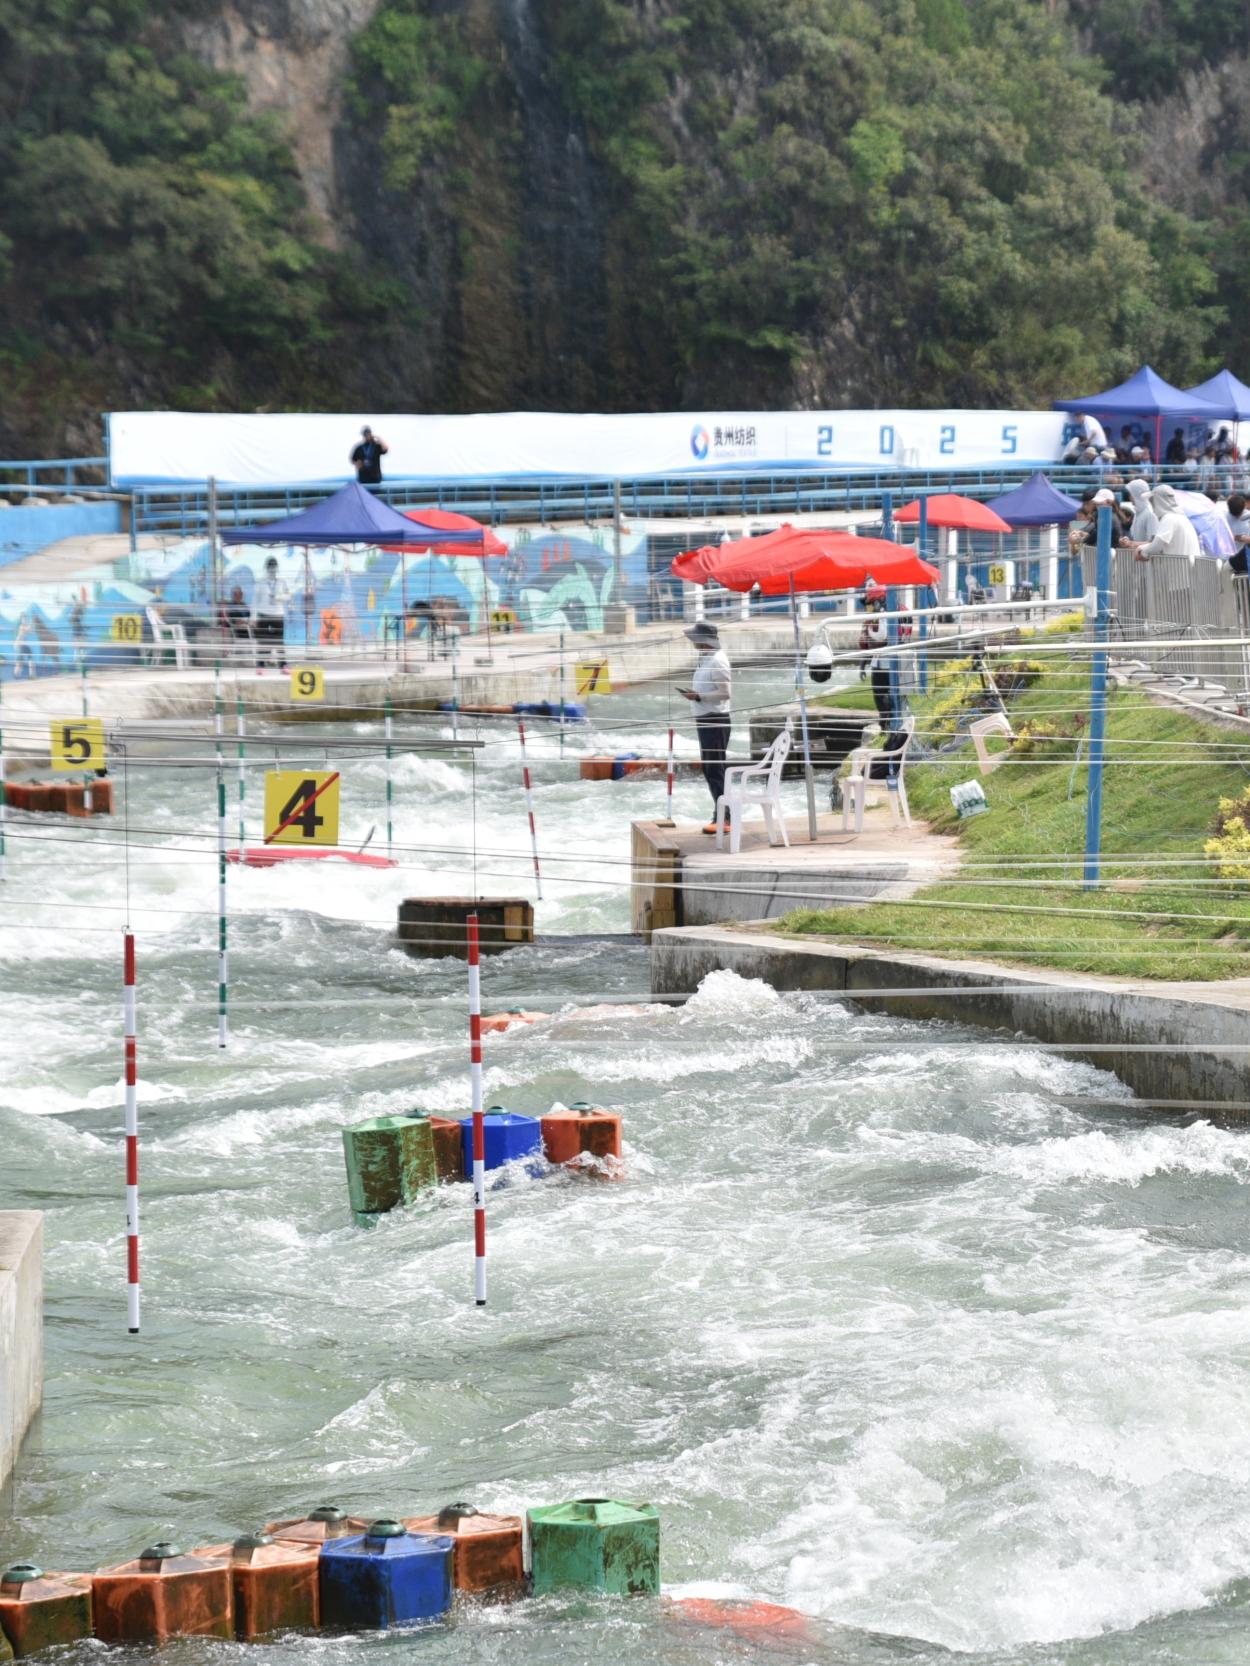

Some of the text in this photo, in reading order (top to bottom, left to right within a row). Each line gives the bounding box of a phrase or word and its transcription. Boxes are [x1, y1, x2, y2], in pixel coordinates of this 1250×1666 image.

[713, 426, 756, 446] 贵州纺织
[990, 567, 1005, 583] 13
[116, 617, 138, 640] 10
[298, 671, 316, 695] 9
[583, 663, 602, 691] 7
[62, 724, 92, 764] 5
[279, 779, 324, 838] 4
